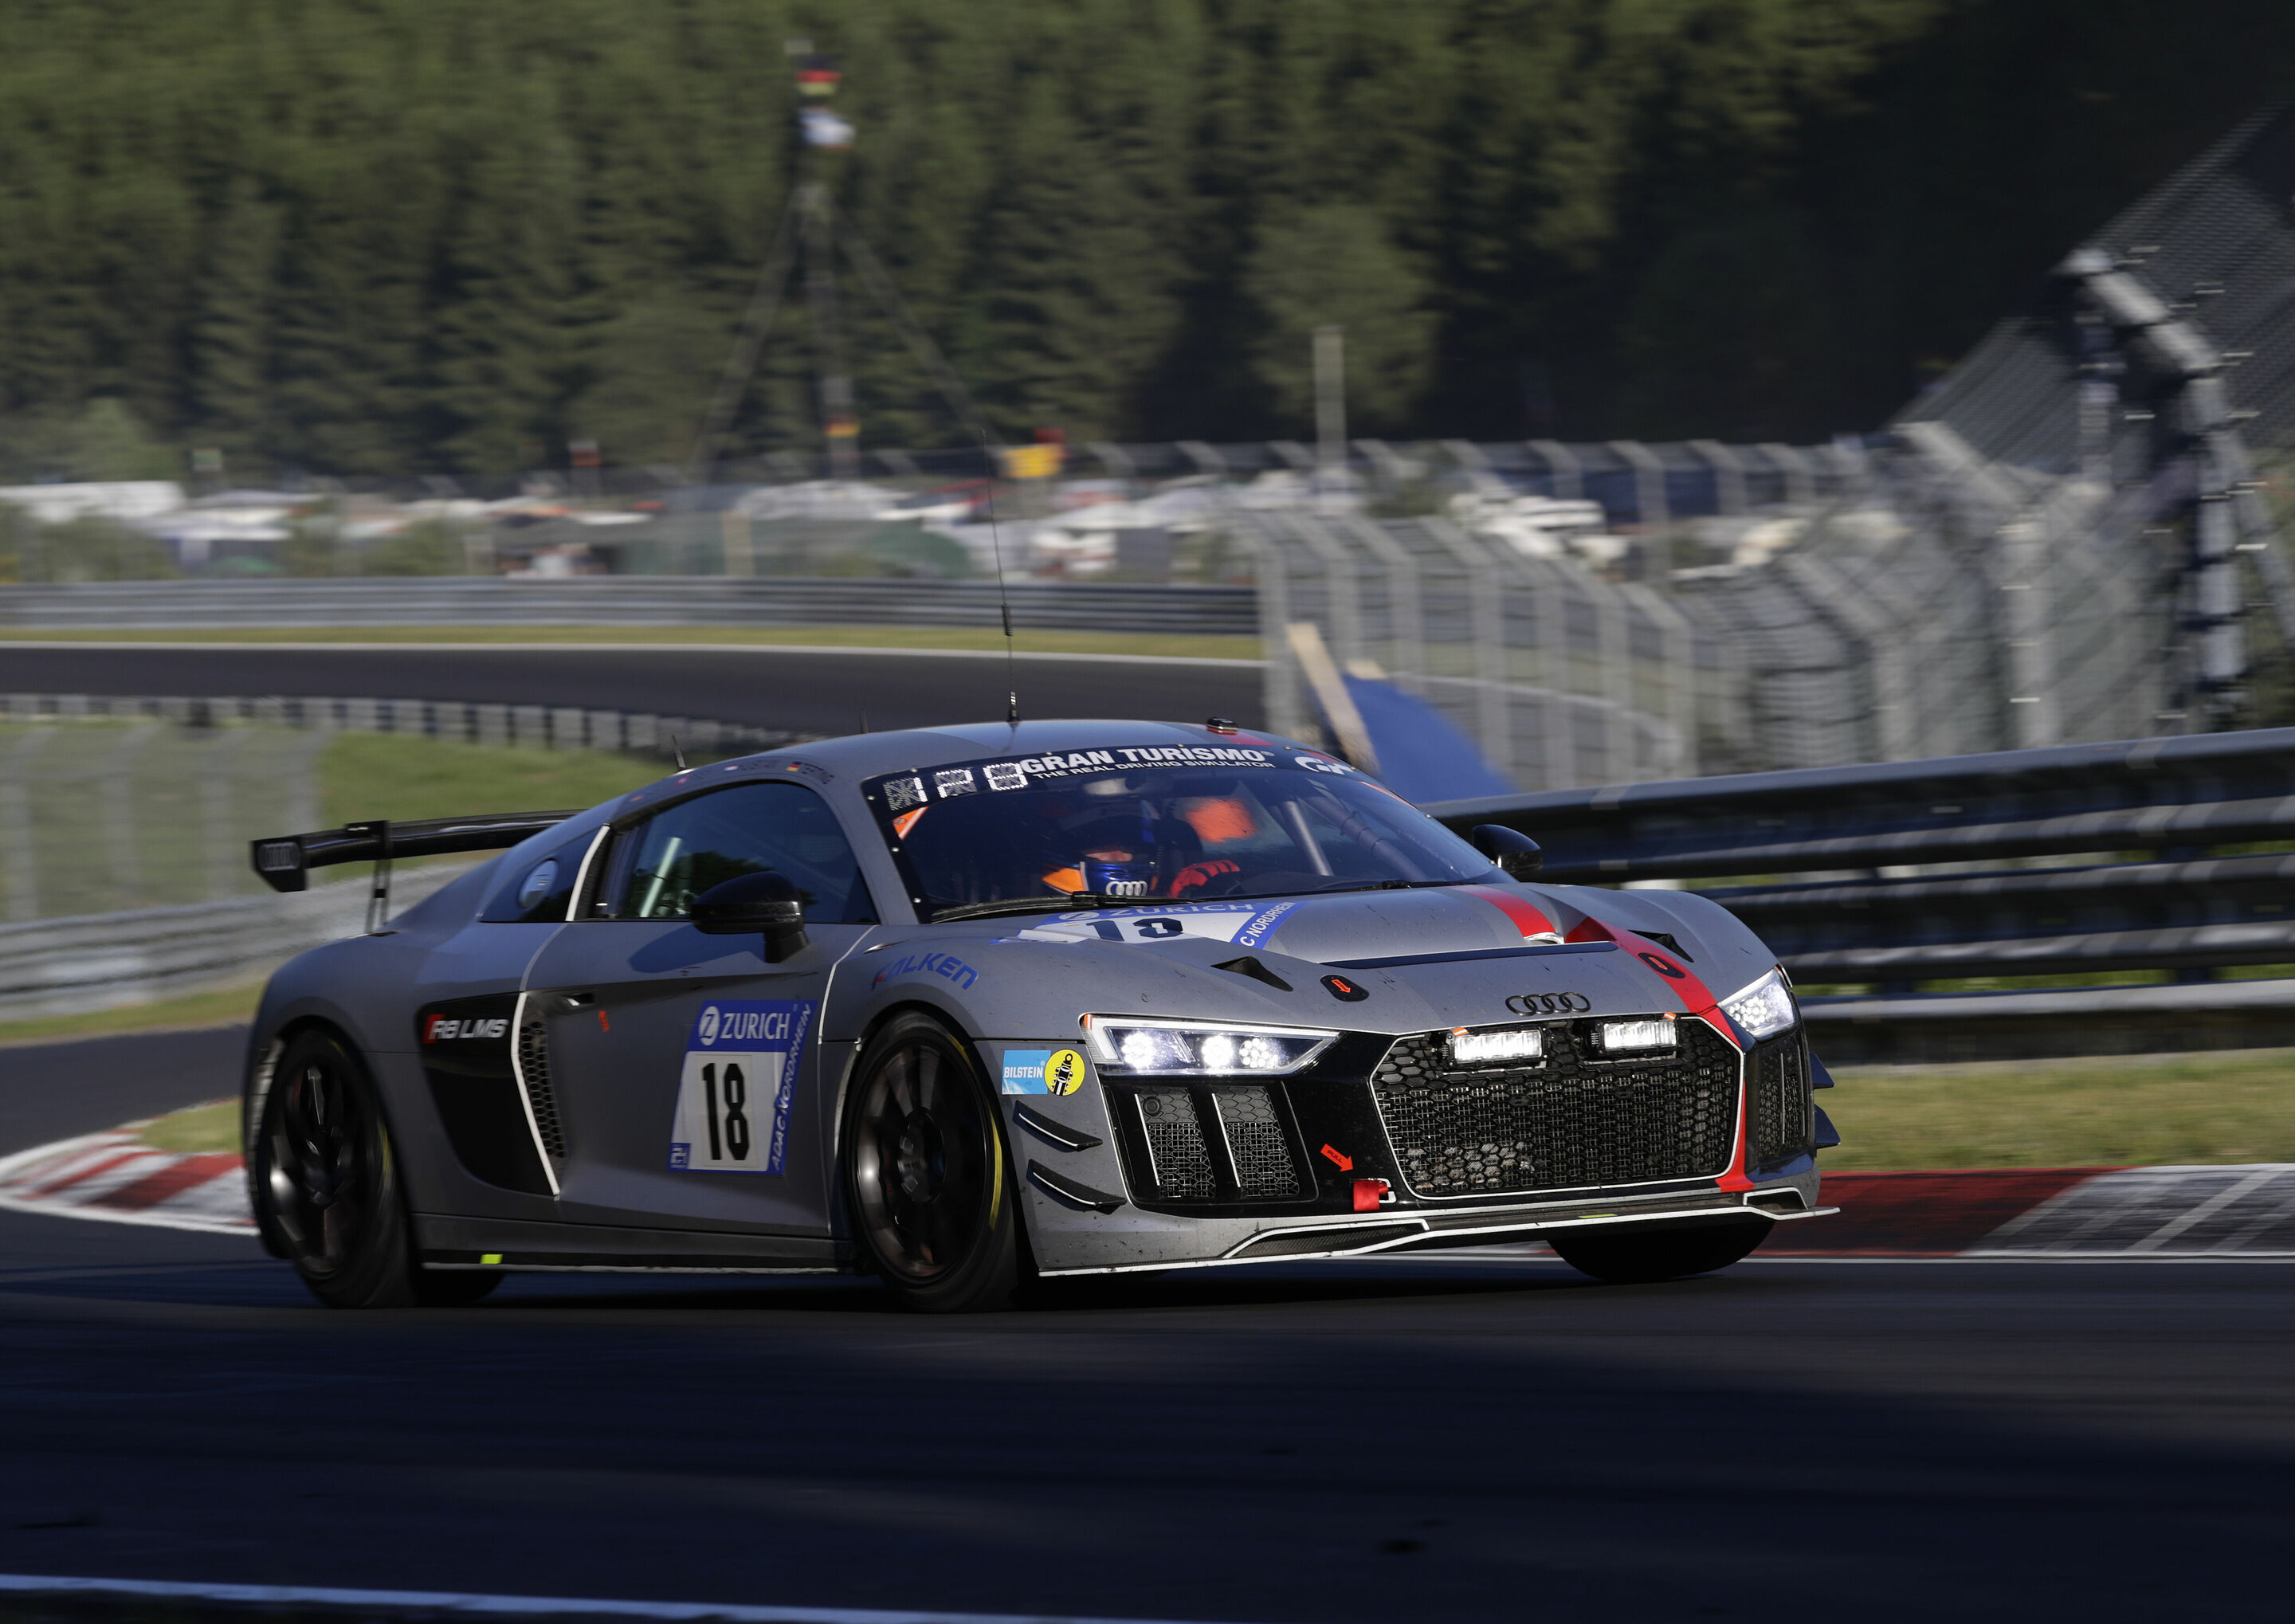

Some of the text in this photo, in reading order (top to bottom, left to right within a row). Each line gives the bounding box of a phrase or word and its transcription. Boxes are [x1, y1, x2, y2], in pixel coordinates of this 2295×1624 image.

[1020, 747, 1266, 774] GRAN TURISMO
[1033, 770, 1069, 779] THE
[1072, 765, 1116, 775] REAL
[1115, 760, 1183, 770] DRIVING
[1108, 903, 1255, 916] ZURICH
[1246, 901, 1297, 939] NORDRHEIN
[458, 1018, 509, 1038] LMS
[720, 1012, 791, 1040] ZURICH
[1004, 1066, 1044, 1078] BILSTEIN
[771, 1002, 812, 1171] ADAC NORDRHEIN
[701, 1062, 750, 1161] 18
[1327, 1149, 1343, 1163] PULL
